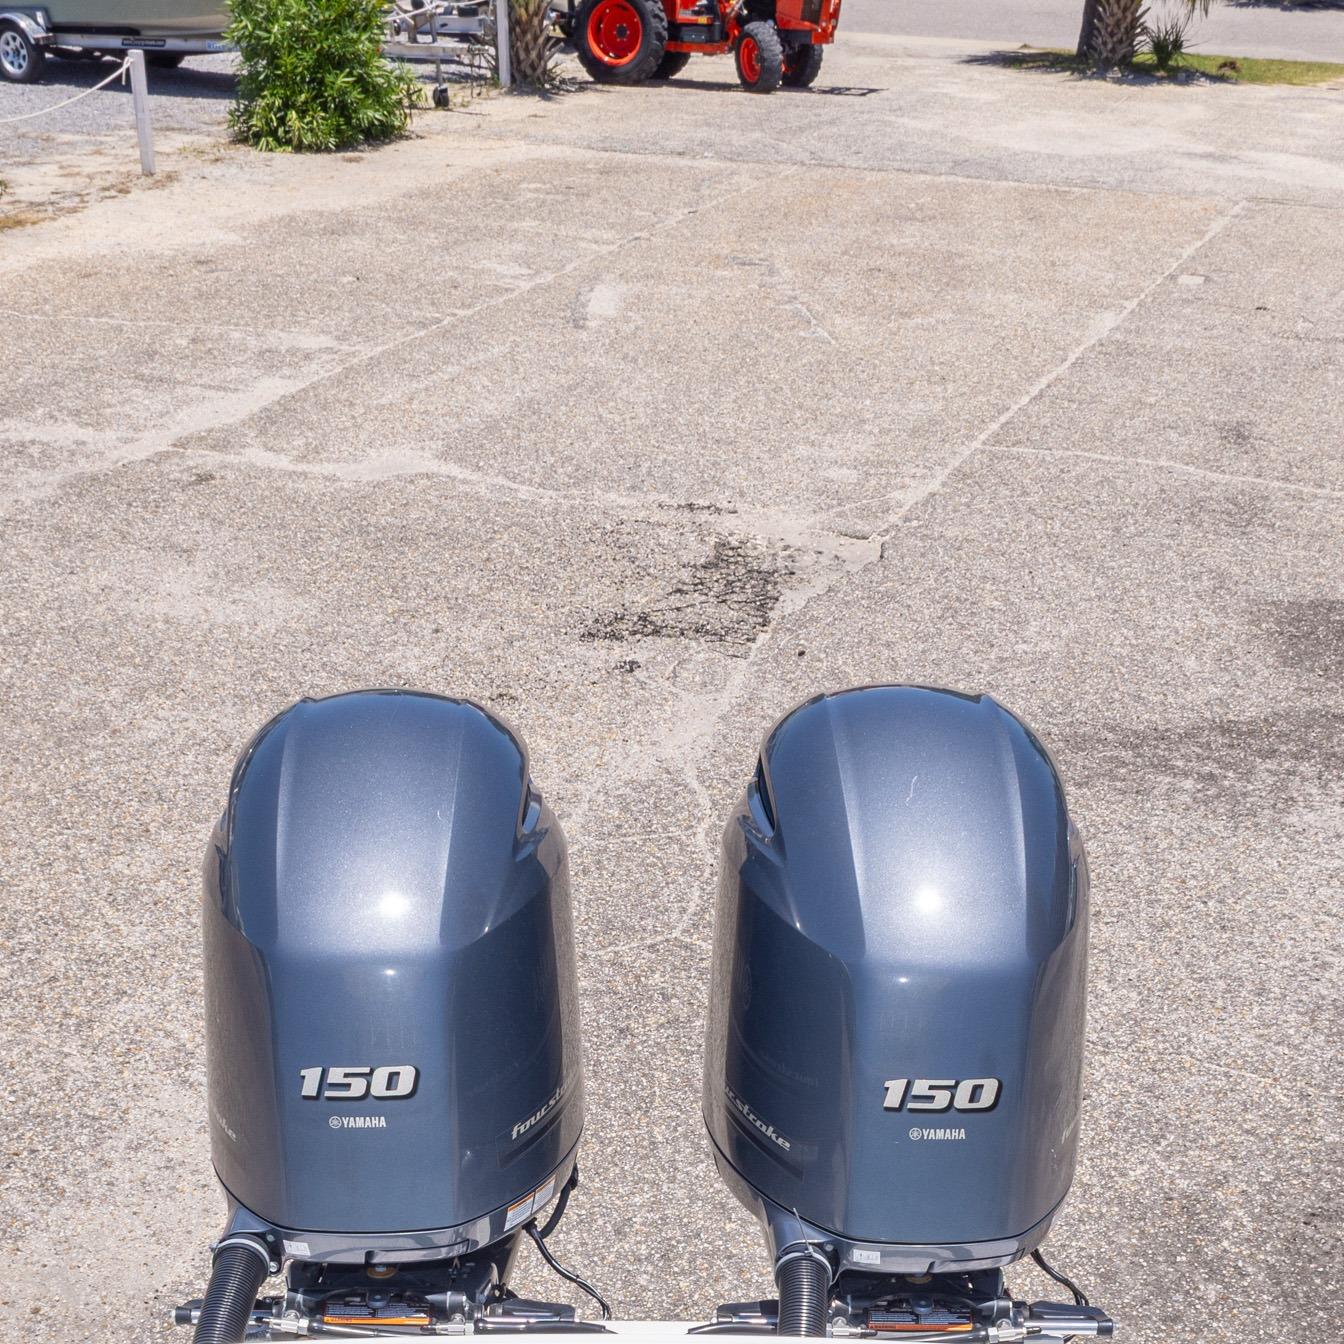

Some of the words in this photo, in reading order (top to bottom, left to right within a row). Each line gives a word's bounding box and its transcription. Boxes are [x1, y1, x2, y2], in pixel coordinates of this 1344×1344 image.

[299, 1064, 419, 1100] 150
[882, 1077, 1001, 1112] 150
[341, 1115, 387, 1128] YAMAHA
[922, 1127, 967, 1140] YAMAHA
